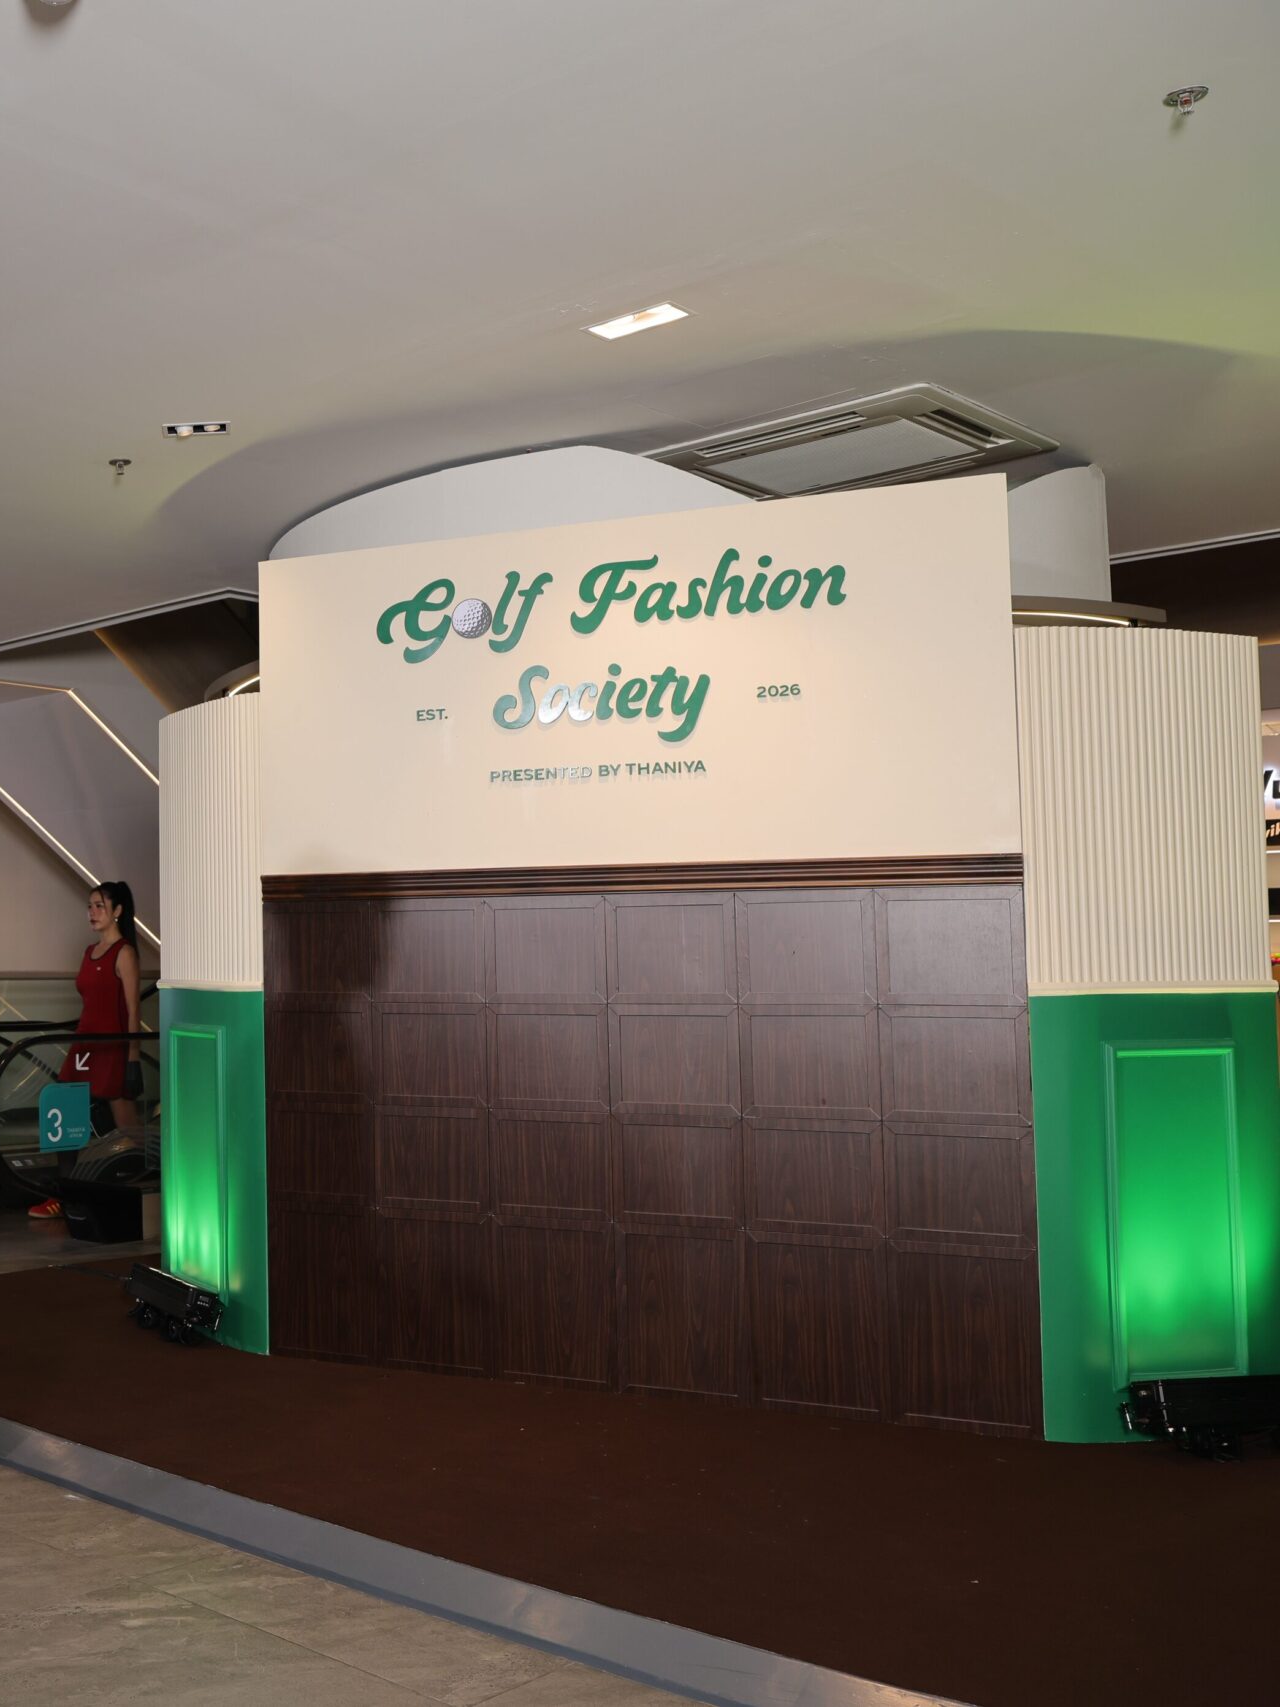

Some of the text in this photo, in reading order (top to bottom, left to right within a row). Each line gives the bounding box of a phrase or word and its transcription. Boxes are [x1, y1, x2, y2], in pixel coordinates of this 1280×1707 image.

[376, 547, 847, 664] Golf Fashion
[492, 663, 711, 743] Society
[756, 683, 801, 699] 2026
[416, 708, 449, 722] EST.
[490, 760, 706, 783] PRESENTED BY THANIYA
[47, 1108, 63, 1143] 3
